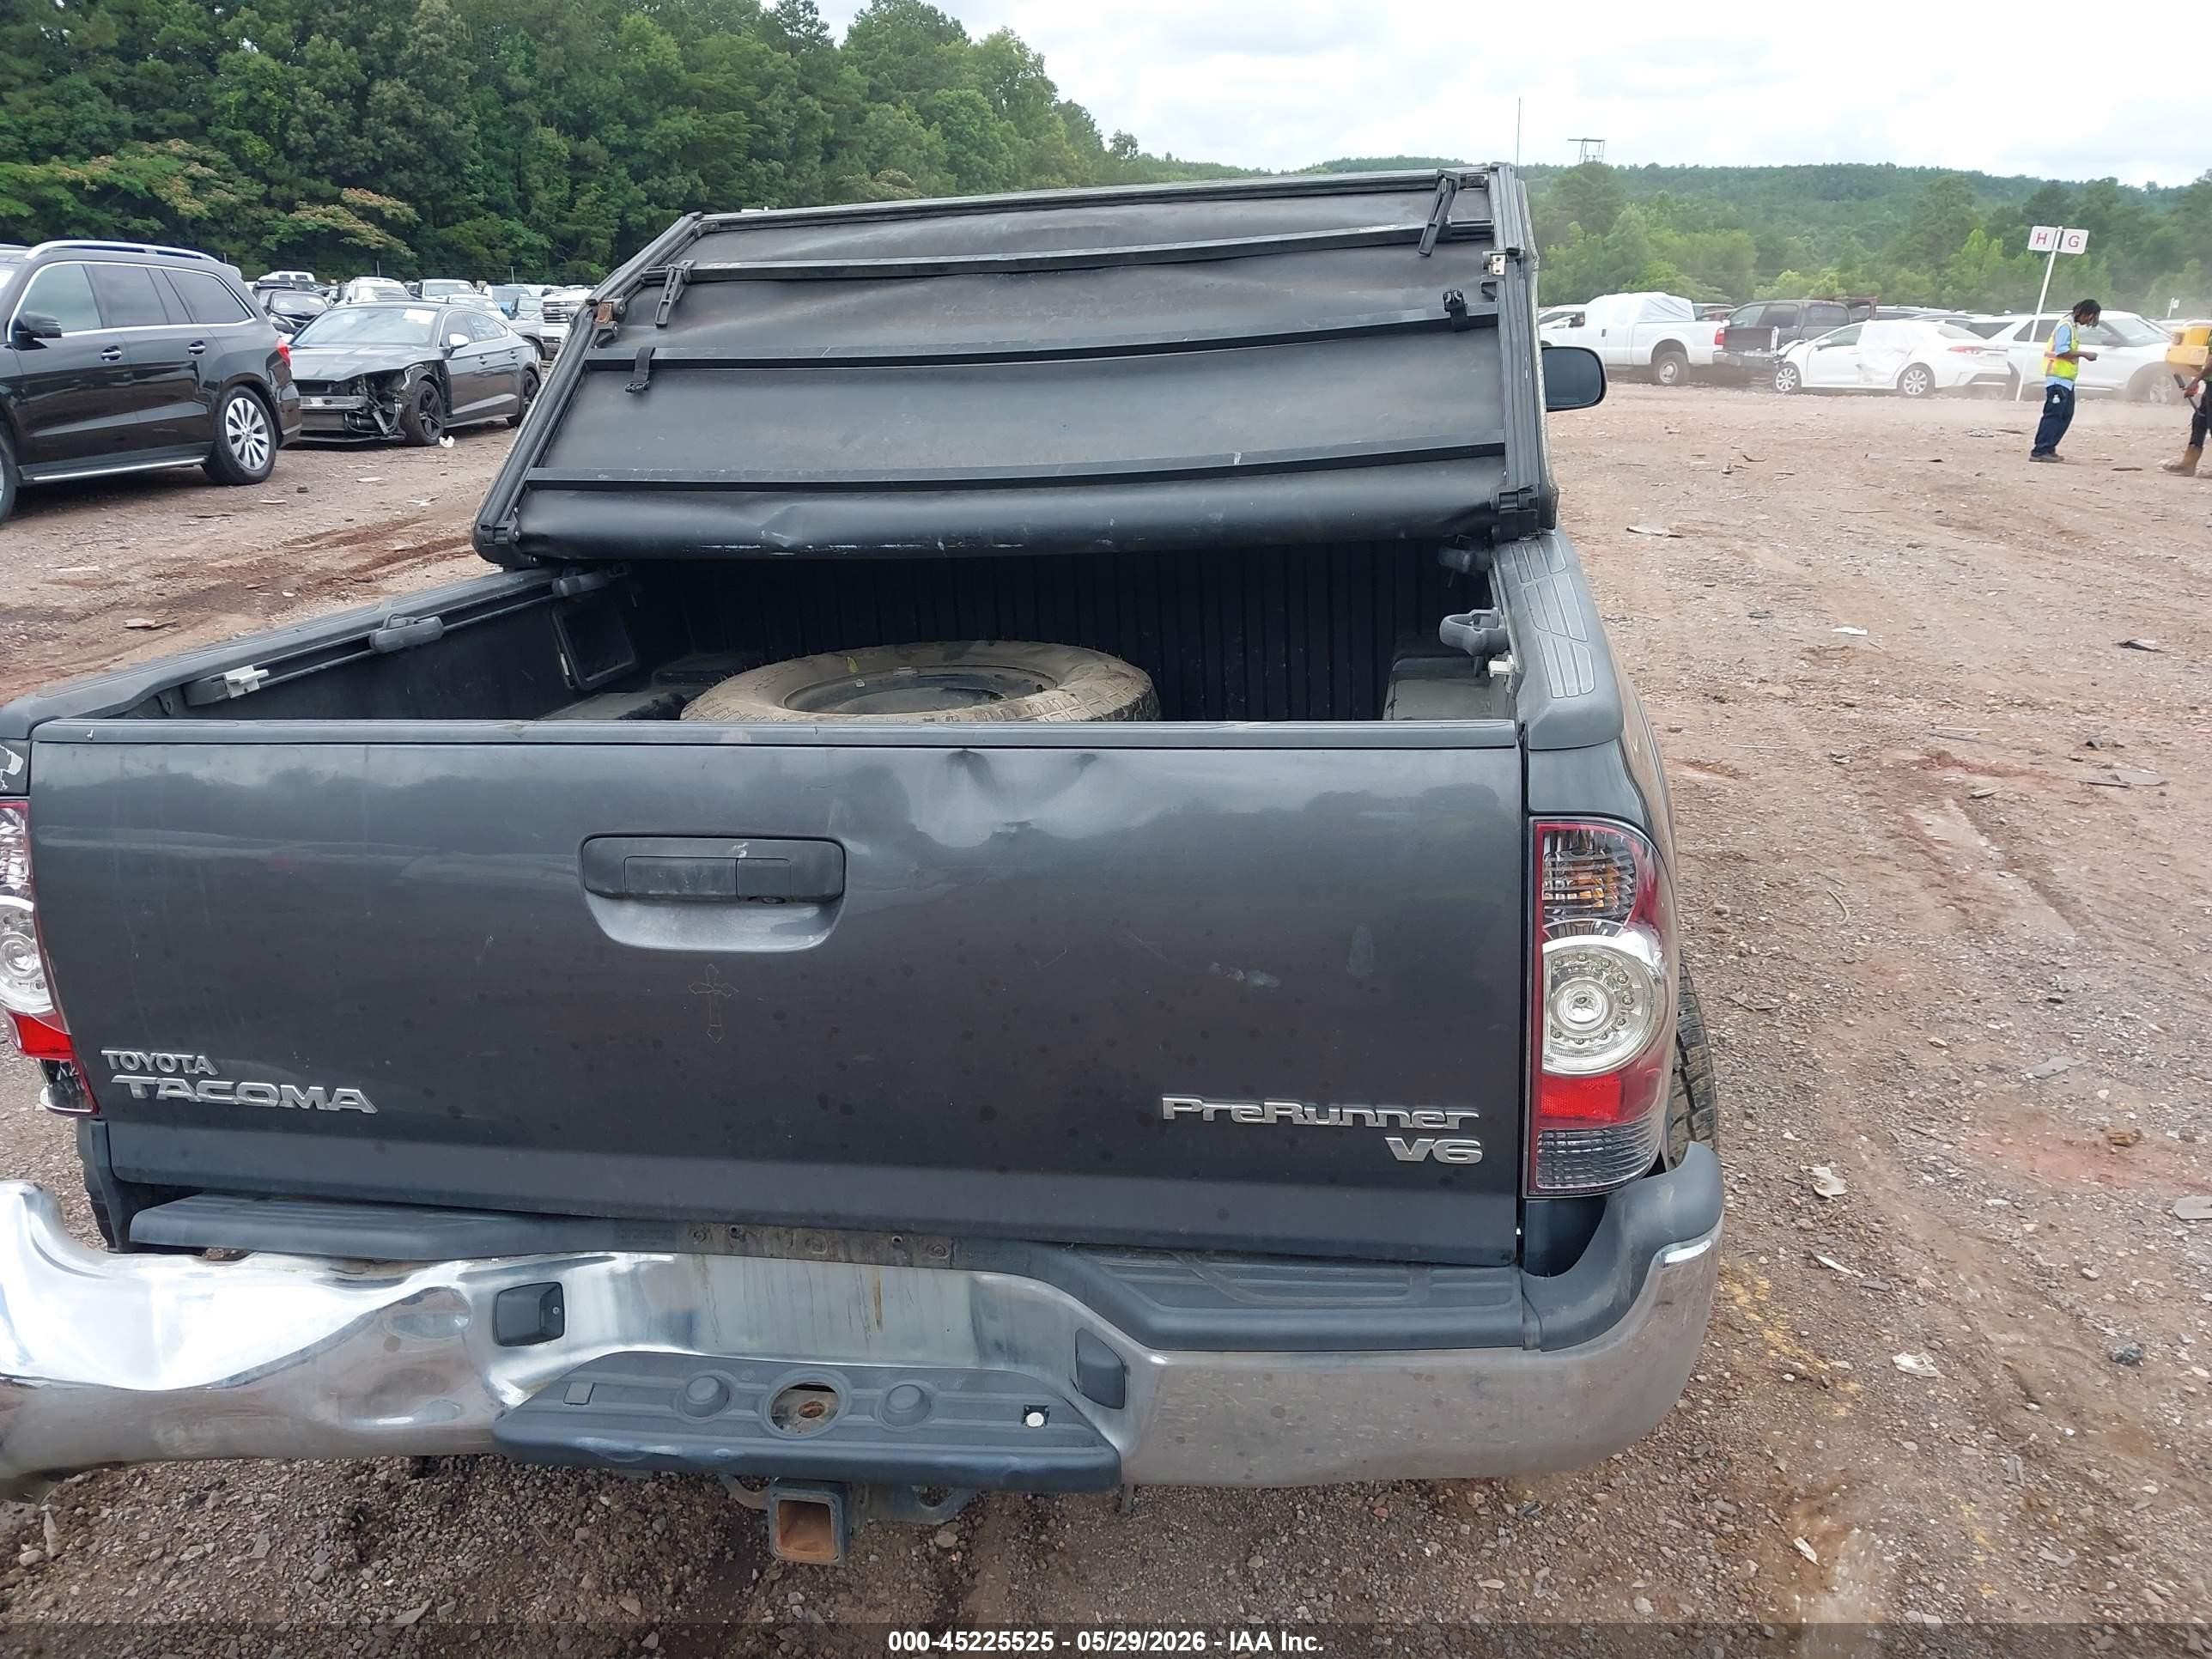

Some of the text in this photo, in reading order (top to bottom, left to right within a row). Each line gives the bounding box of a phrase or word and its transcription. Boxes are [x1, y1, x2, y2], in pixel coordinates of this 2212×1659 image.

[2035, 232, 2048, 245] H
[2068, 234, 2081, 247] G
[100, 1048, 220, 1076] TOYOTA
[111, 1074, 378, 1115] TACOMA
[1162, 1095, 1480, 1130] PreRunner
[1384, 1136, 1484, 1164] V6
